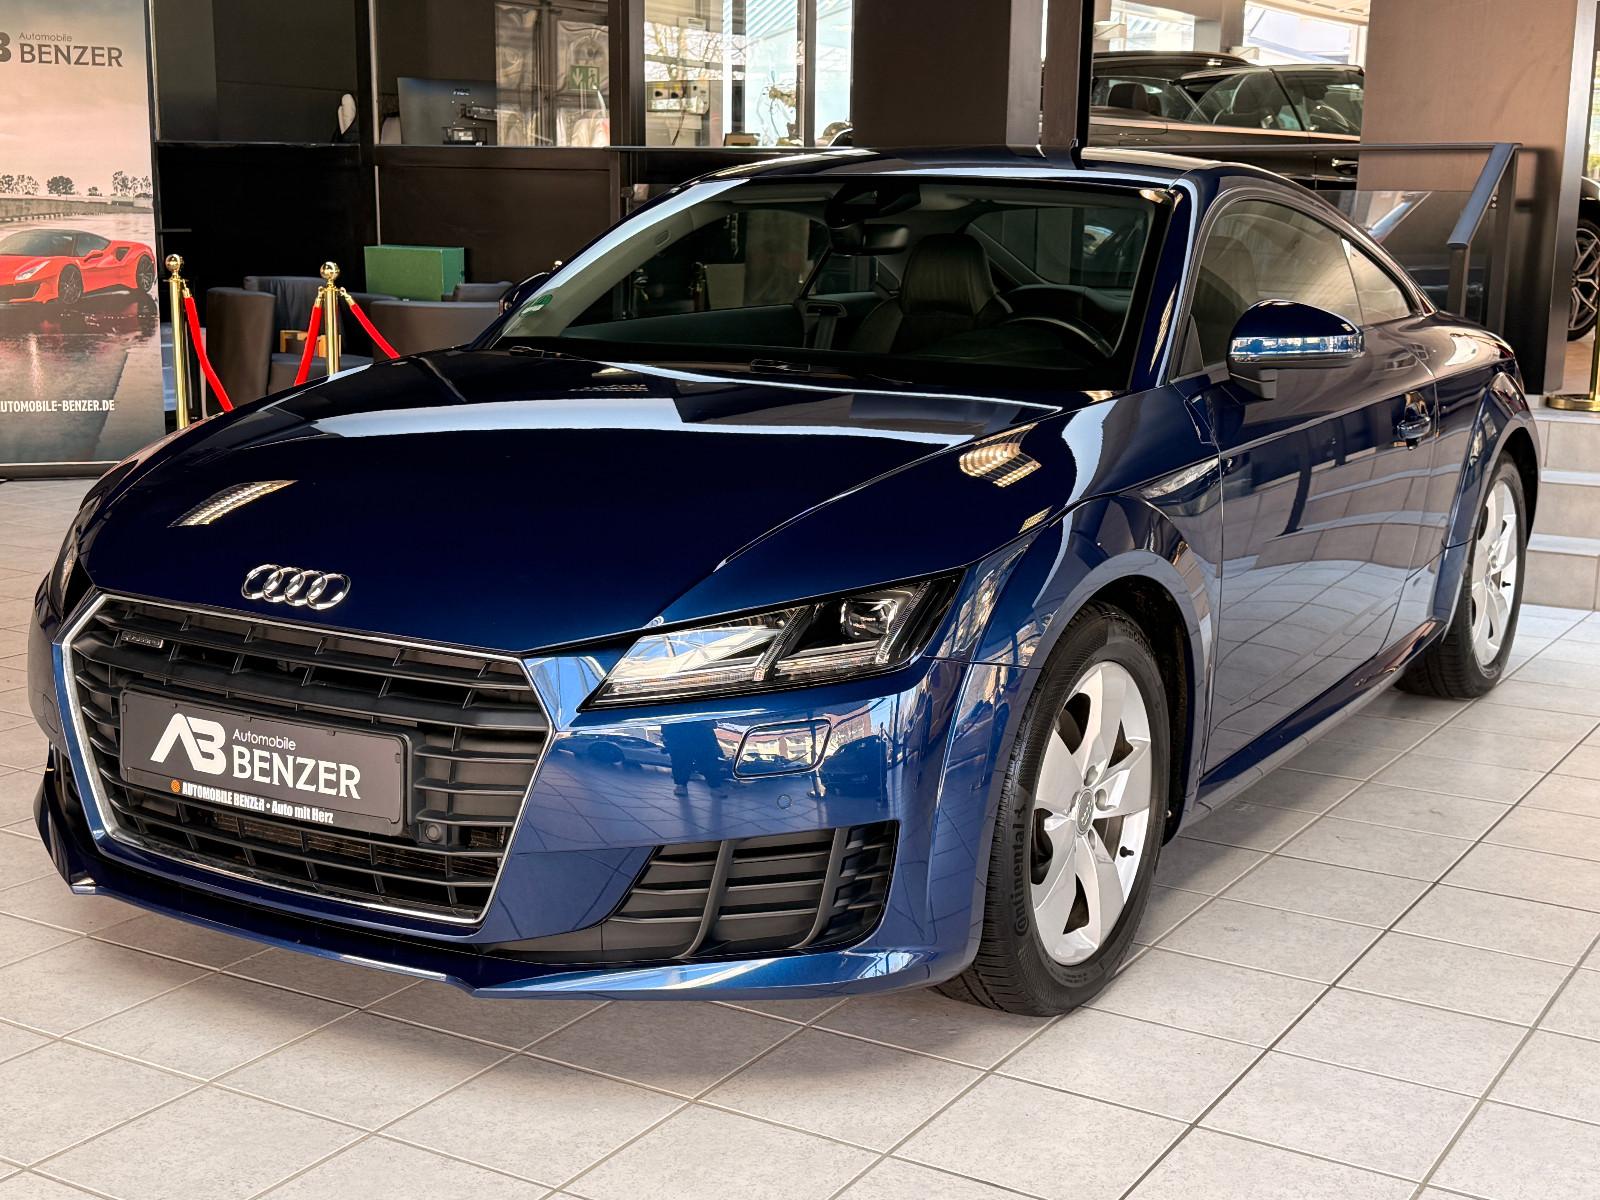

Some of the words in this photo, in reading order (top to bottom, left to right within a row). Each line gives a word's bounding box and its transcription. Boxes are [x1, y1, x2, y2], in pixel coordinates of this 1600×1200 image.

[19, 32, 73, 42] Automobile
[19, 43, 124, 67] BENZER
[0, 399, 115, 412] UTOMOBILE-BENZER.DE
[232, 728, 297, 751] Automobile
[232, 745, 361, 799] BENZER
[182, 781, 233, 804] AUTOMOBILE
[233, 793, 265, 811] BENZER
[271, 800, 293, 817] Auto
[294, 805, 311, 820] mit
[311, 807, 334, 824] Herz
[1011, 823, 1029, 936] Continental
